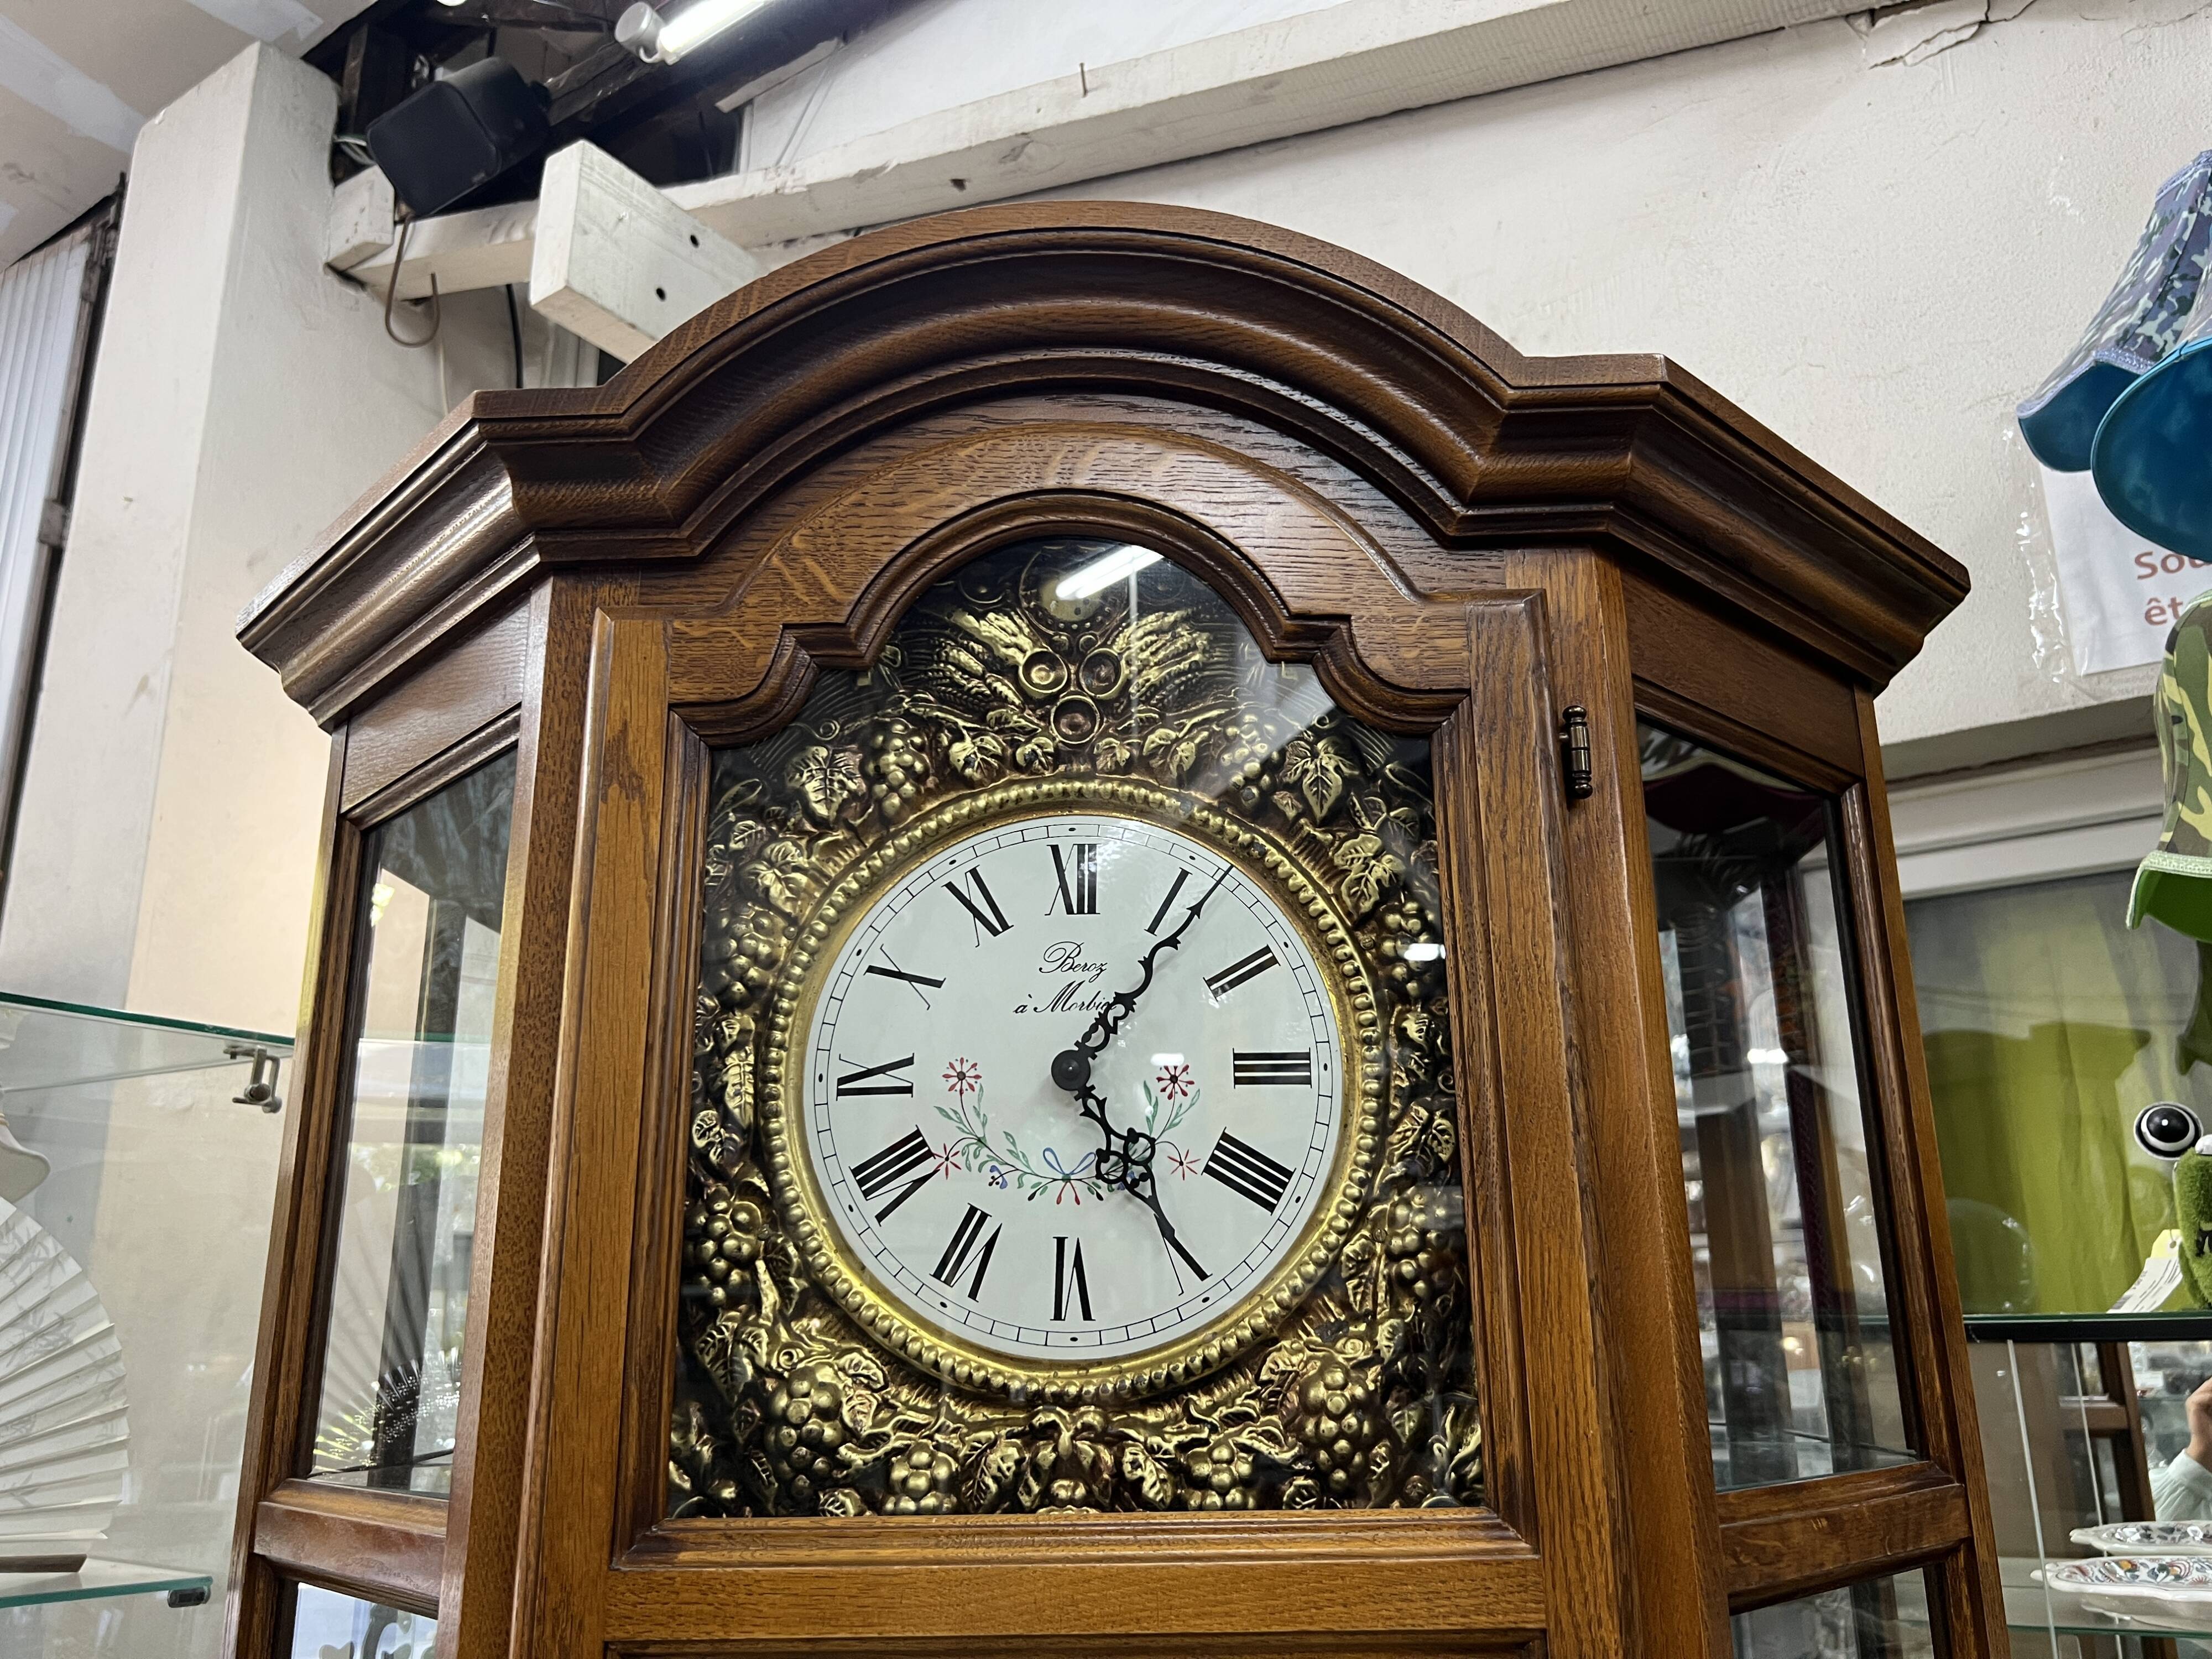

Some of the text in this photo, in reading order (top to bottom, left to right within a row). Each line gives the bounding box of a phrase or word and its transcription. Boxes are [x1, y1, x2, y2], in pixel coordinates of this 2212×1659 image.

[943, 865, 1014, 947] XI
[1045, 843, 1100, 916] XII
[1144, 867, 1190, 936] I
[864, 944, 946, 1010] X
[1039, 941, 1108, 983] Beroz
[1203, 944, 1281, 999] II
[1013, 994, 1032, 1014] à
[836, 1053, 914, 1101] IX
[1233, 1047, 1312, 1089] III
[848, 1124, 941, 1227] VIII
[1201, 1126, 1296, 1216] IIII
[929, 1203, 1003, 1303] VII
[1050, 1237, 1096, 1321] VI
[1154, 1213, 1213, 1296] V
